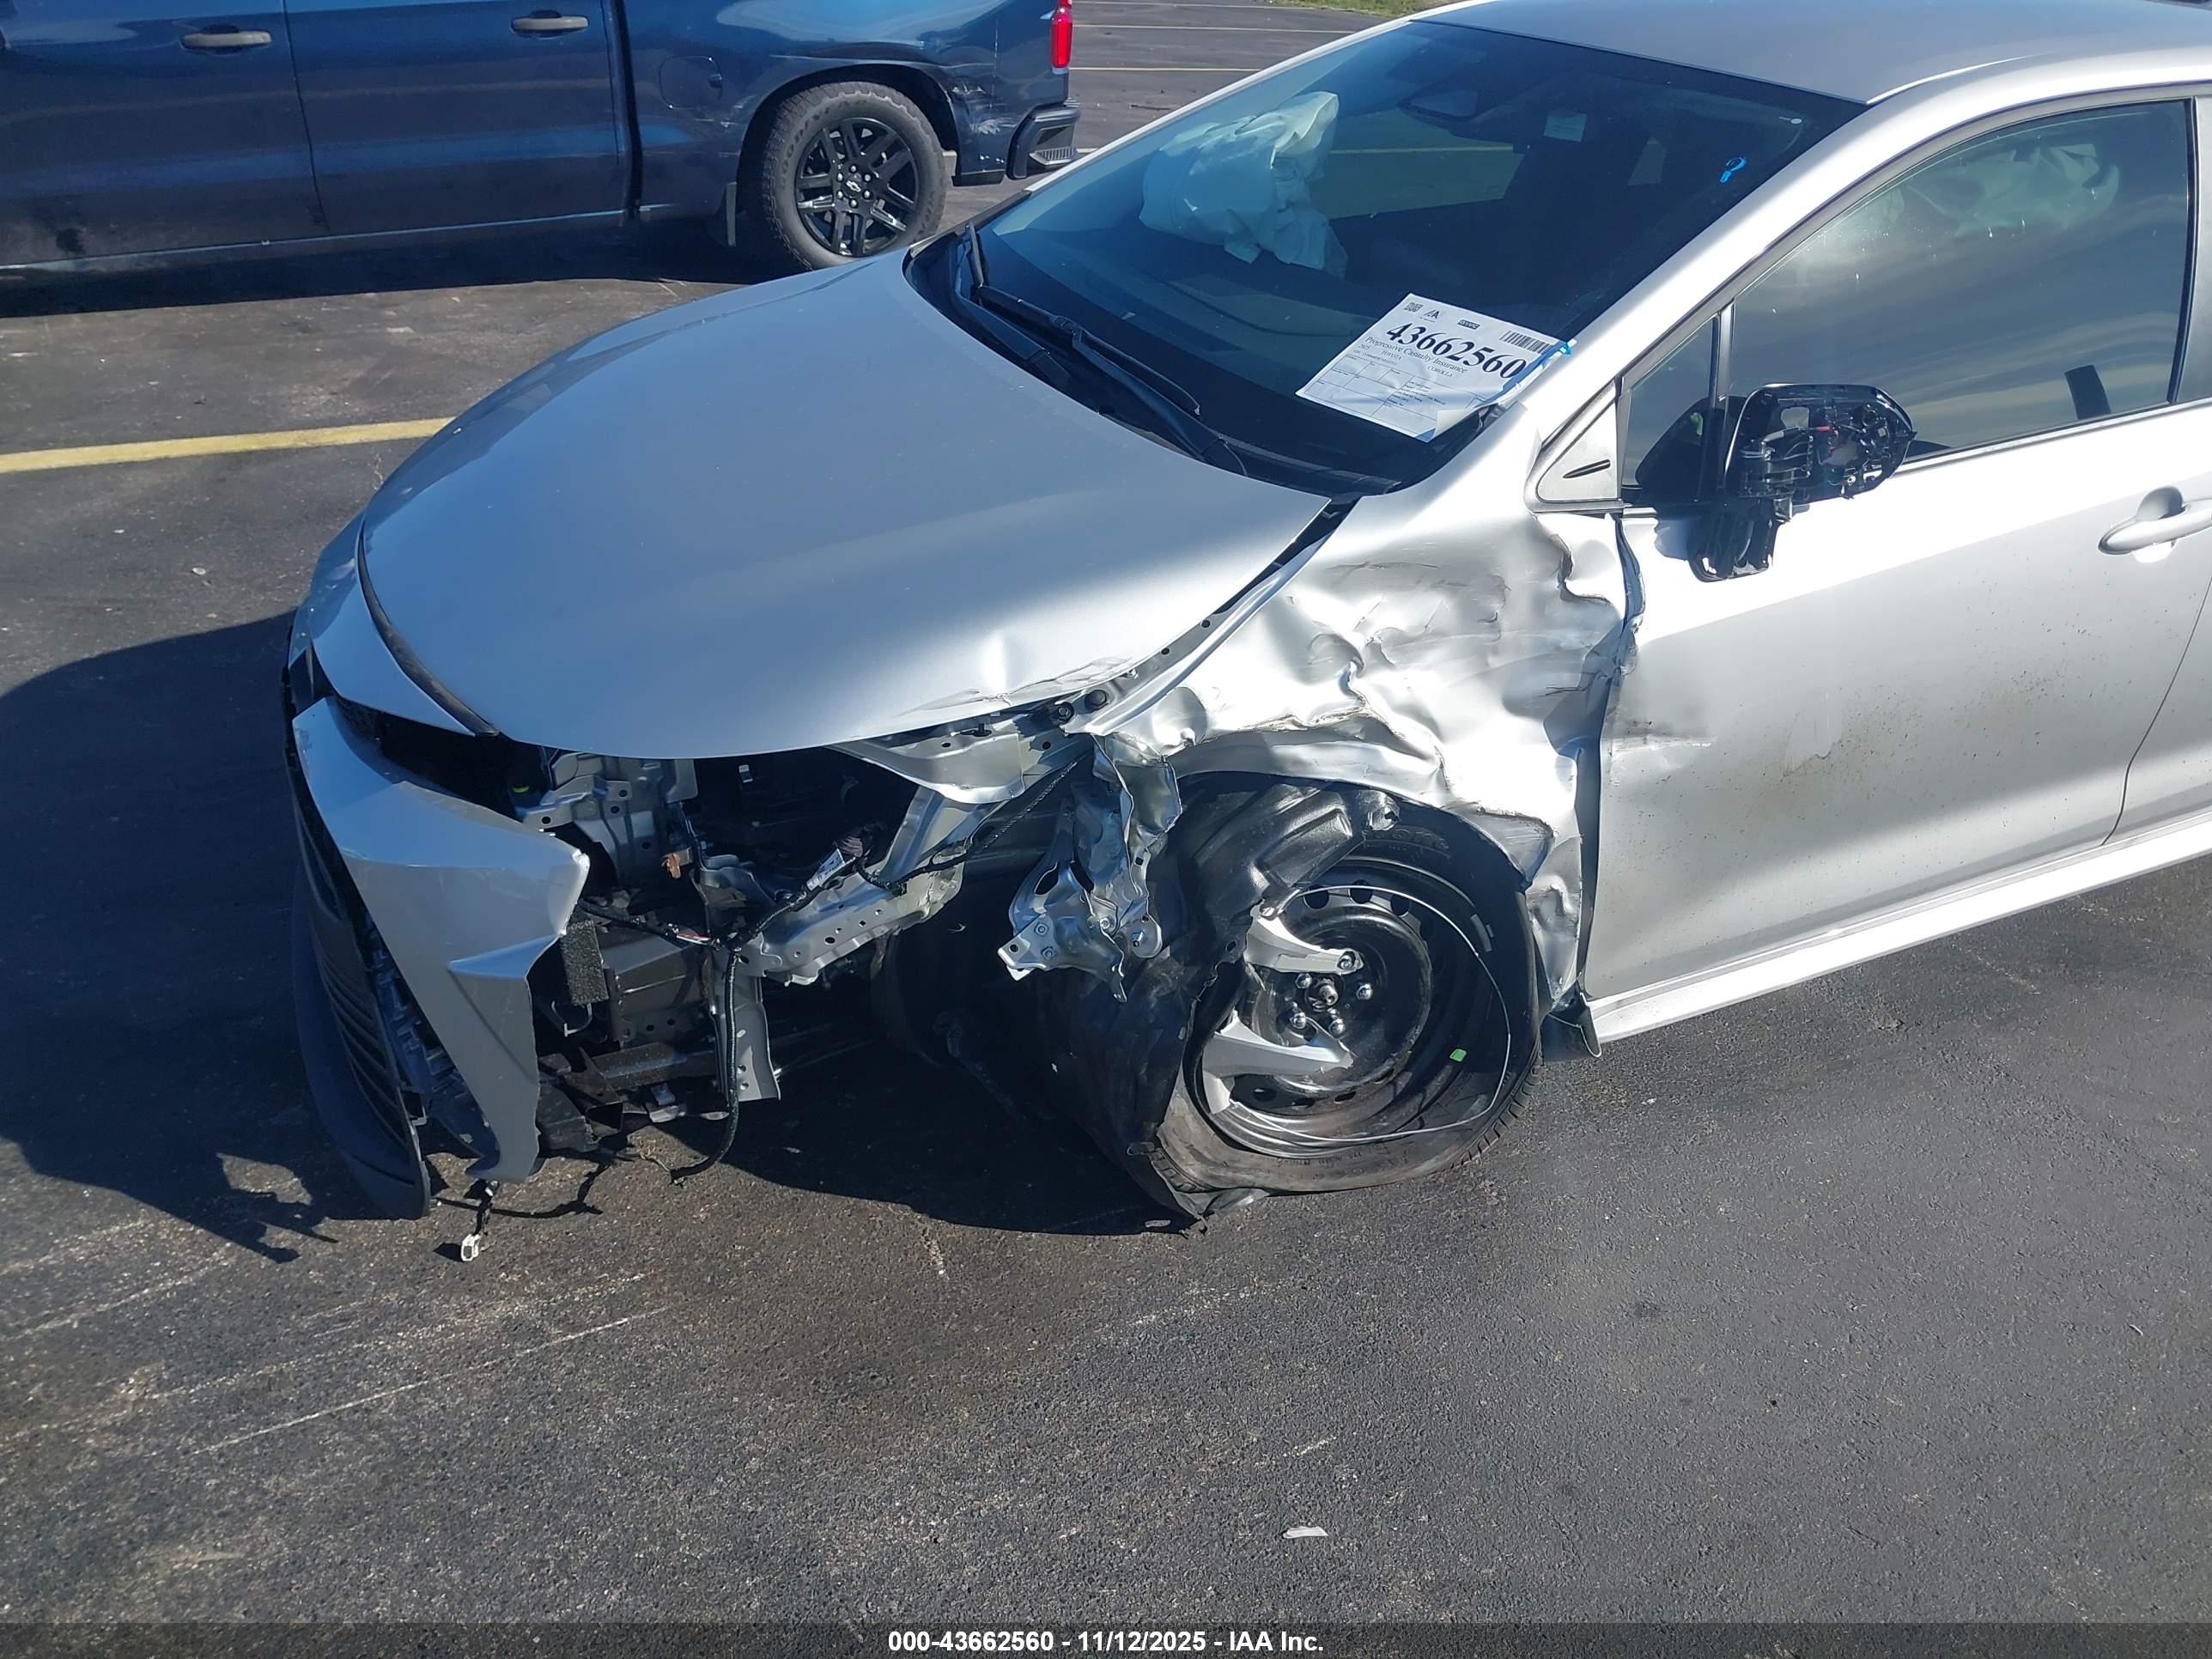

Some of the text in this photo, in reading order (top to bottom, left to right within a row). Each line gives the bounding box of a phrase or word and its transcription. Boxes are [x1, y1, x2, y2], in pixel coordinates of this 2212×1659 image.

[1365, 336, 1403, 353] Progressive
[1403, 348, 1432, 362] Casualty
[1432, 357, 1468, 374] Insurance
[1386, 323, 1527, 378] 43662560
